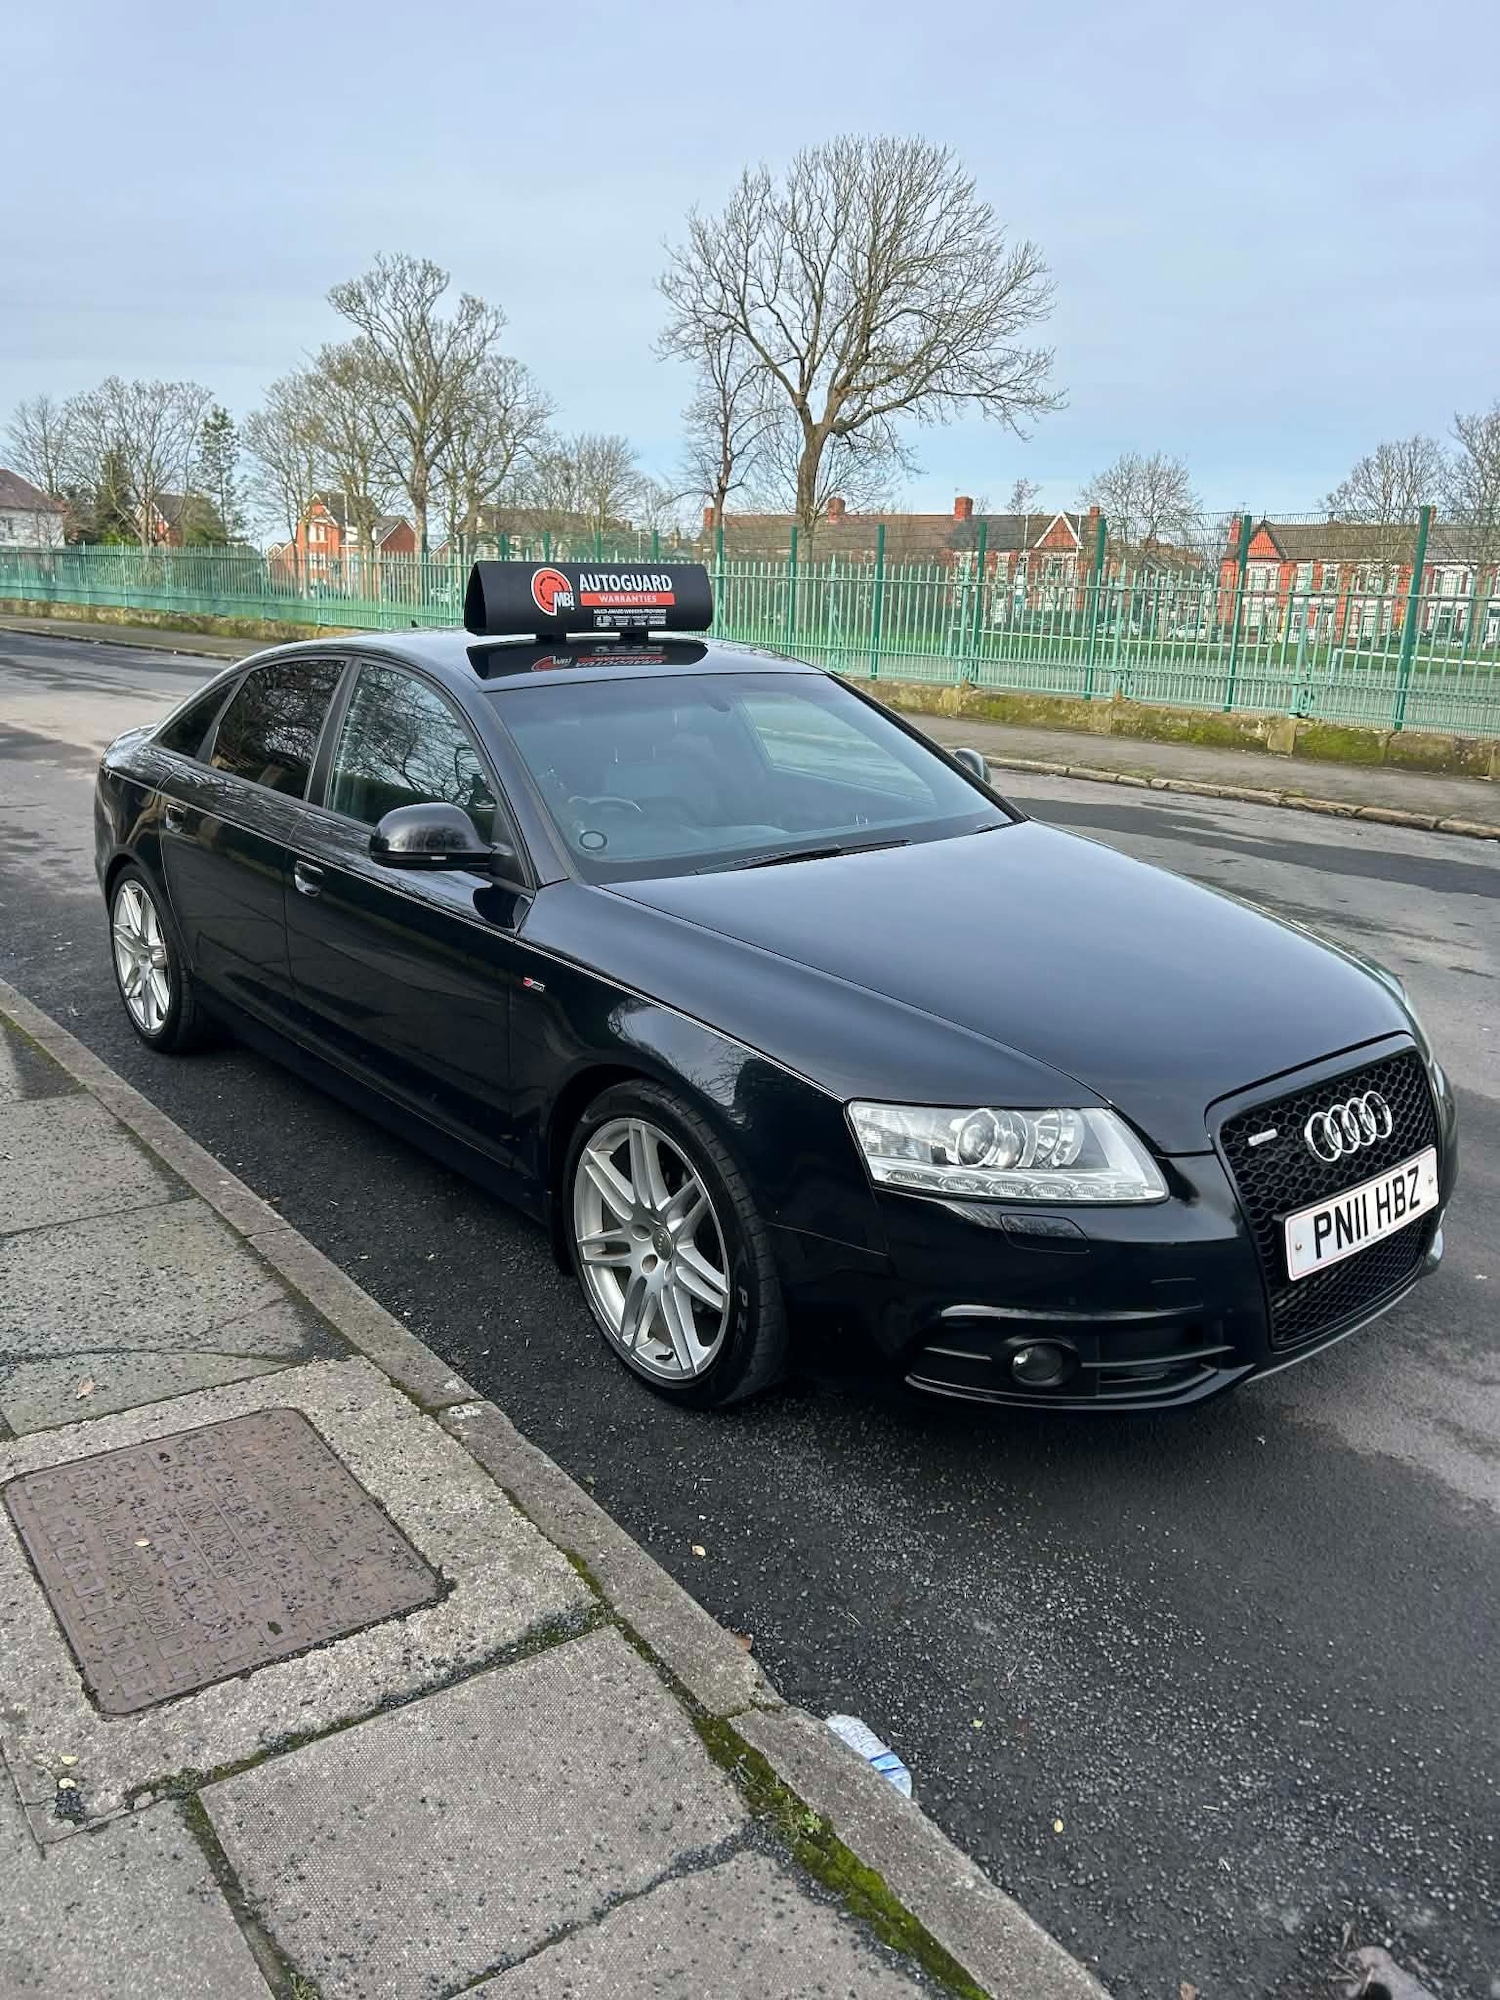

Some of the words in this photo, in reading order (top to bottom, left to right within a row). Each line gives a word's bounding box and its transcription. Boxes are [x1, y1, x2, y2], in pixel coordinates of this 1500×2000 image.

[579, 574, 673, 592] AUTOGUARD
[598, 594, 658, 604] WARRANTIES
[1315, 1195, 1368, 1260] PN11
[1375, 1165, 1421, 1229] HBZ
